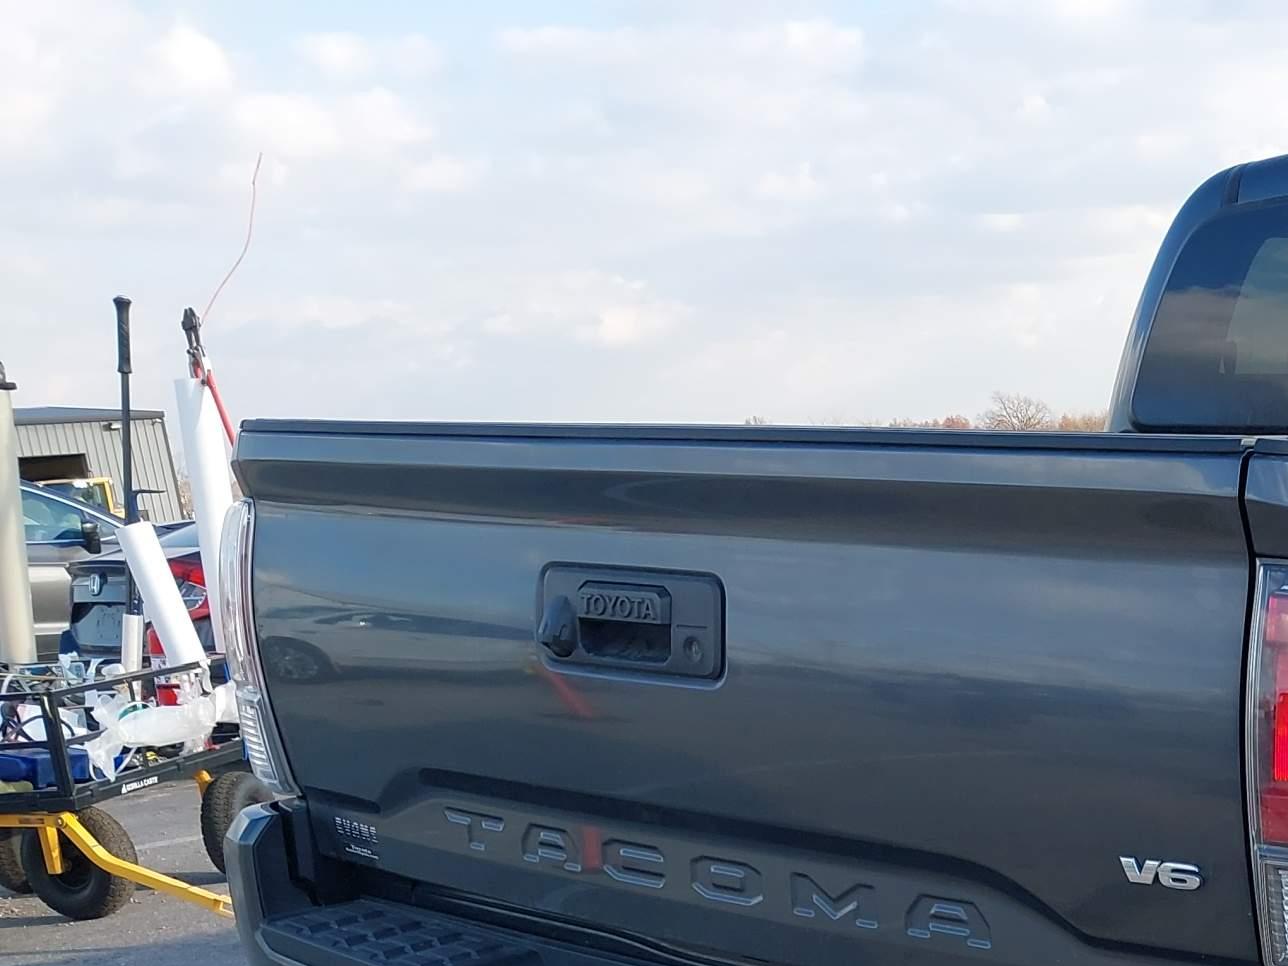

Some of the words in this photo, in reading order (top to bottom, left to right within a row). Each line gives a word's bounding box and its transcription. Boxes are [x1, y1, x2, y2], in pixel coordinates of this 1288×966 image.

[581, 592, 657, 621] TOYOTA
[443, 807, 994, 949] TACOMA
[1118, 855, 1201, 891] V6
